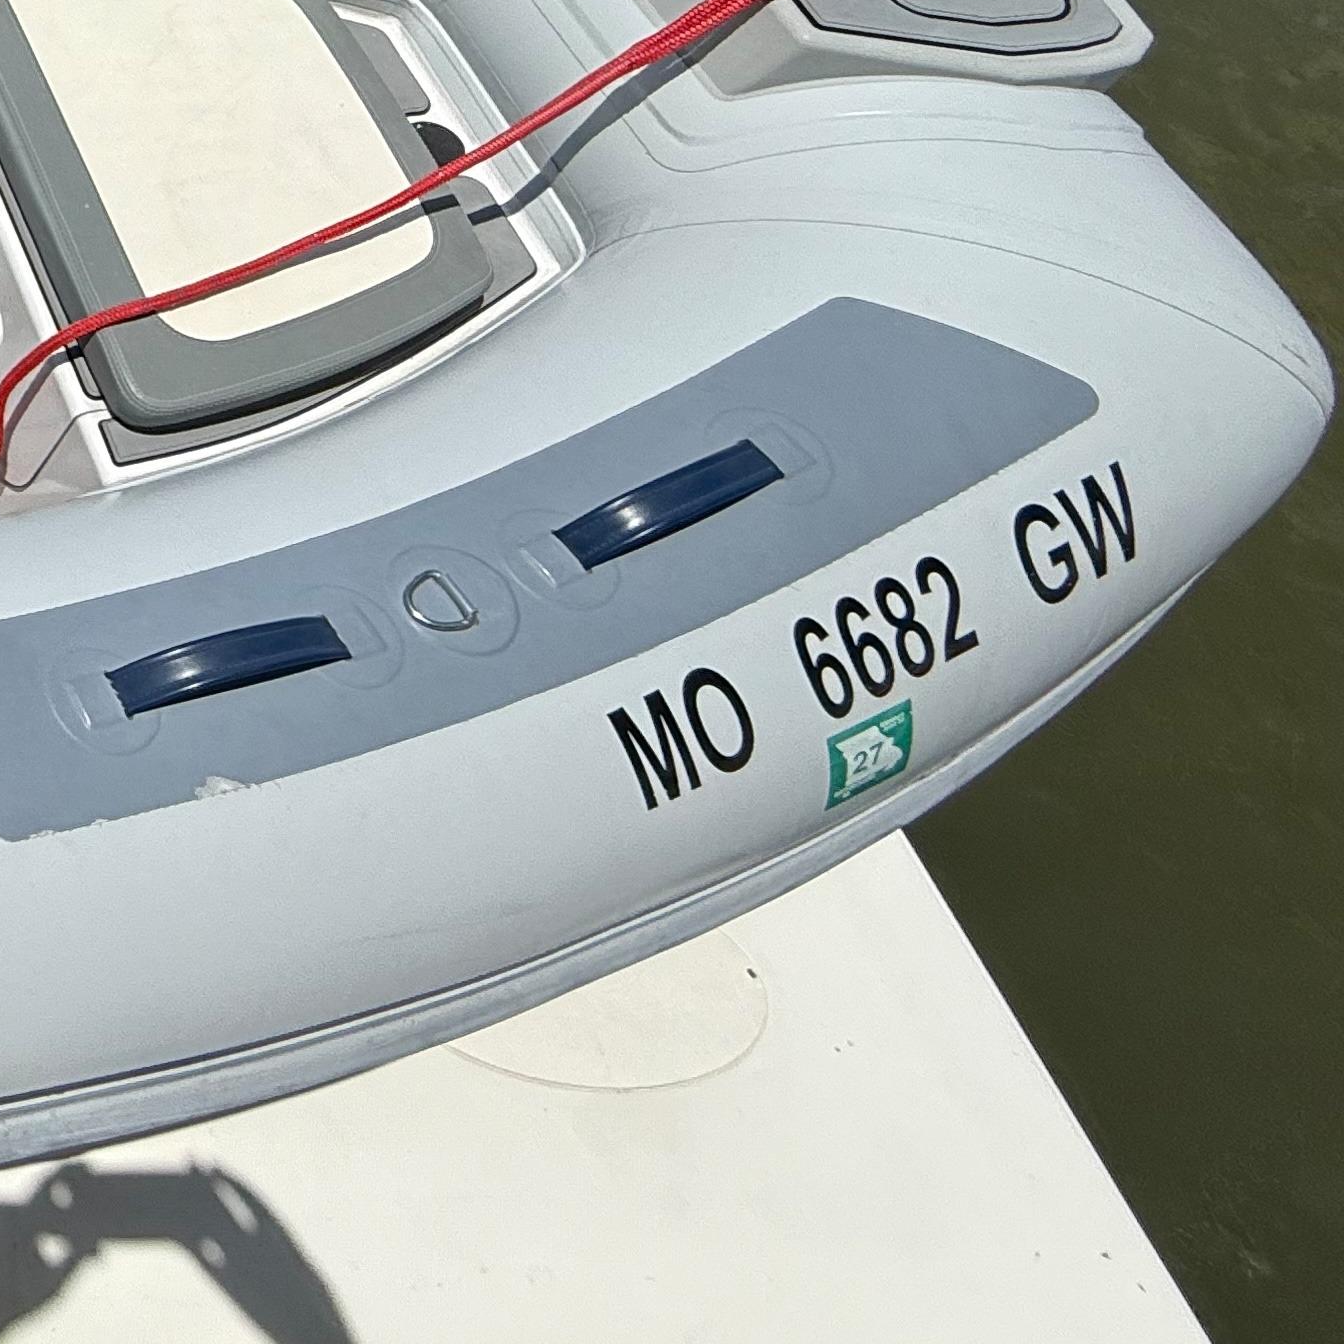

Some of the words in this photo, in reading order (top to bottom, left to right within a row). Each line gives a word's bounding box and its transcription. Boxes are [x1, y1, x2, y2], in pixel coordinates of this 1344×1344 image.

[607, 668, 755, 810] MO
[793, 556, 979, 718] 6682
[1014, 462, 1136, 604] GW
[853, 741, 885, 775] 27
